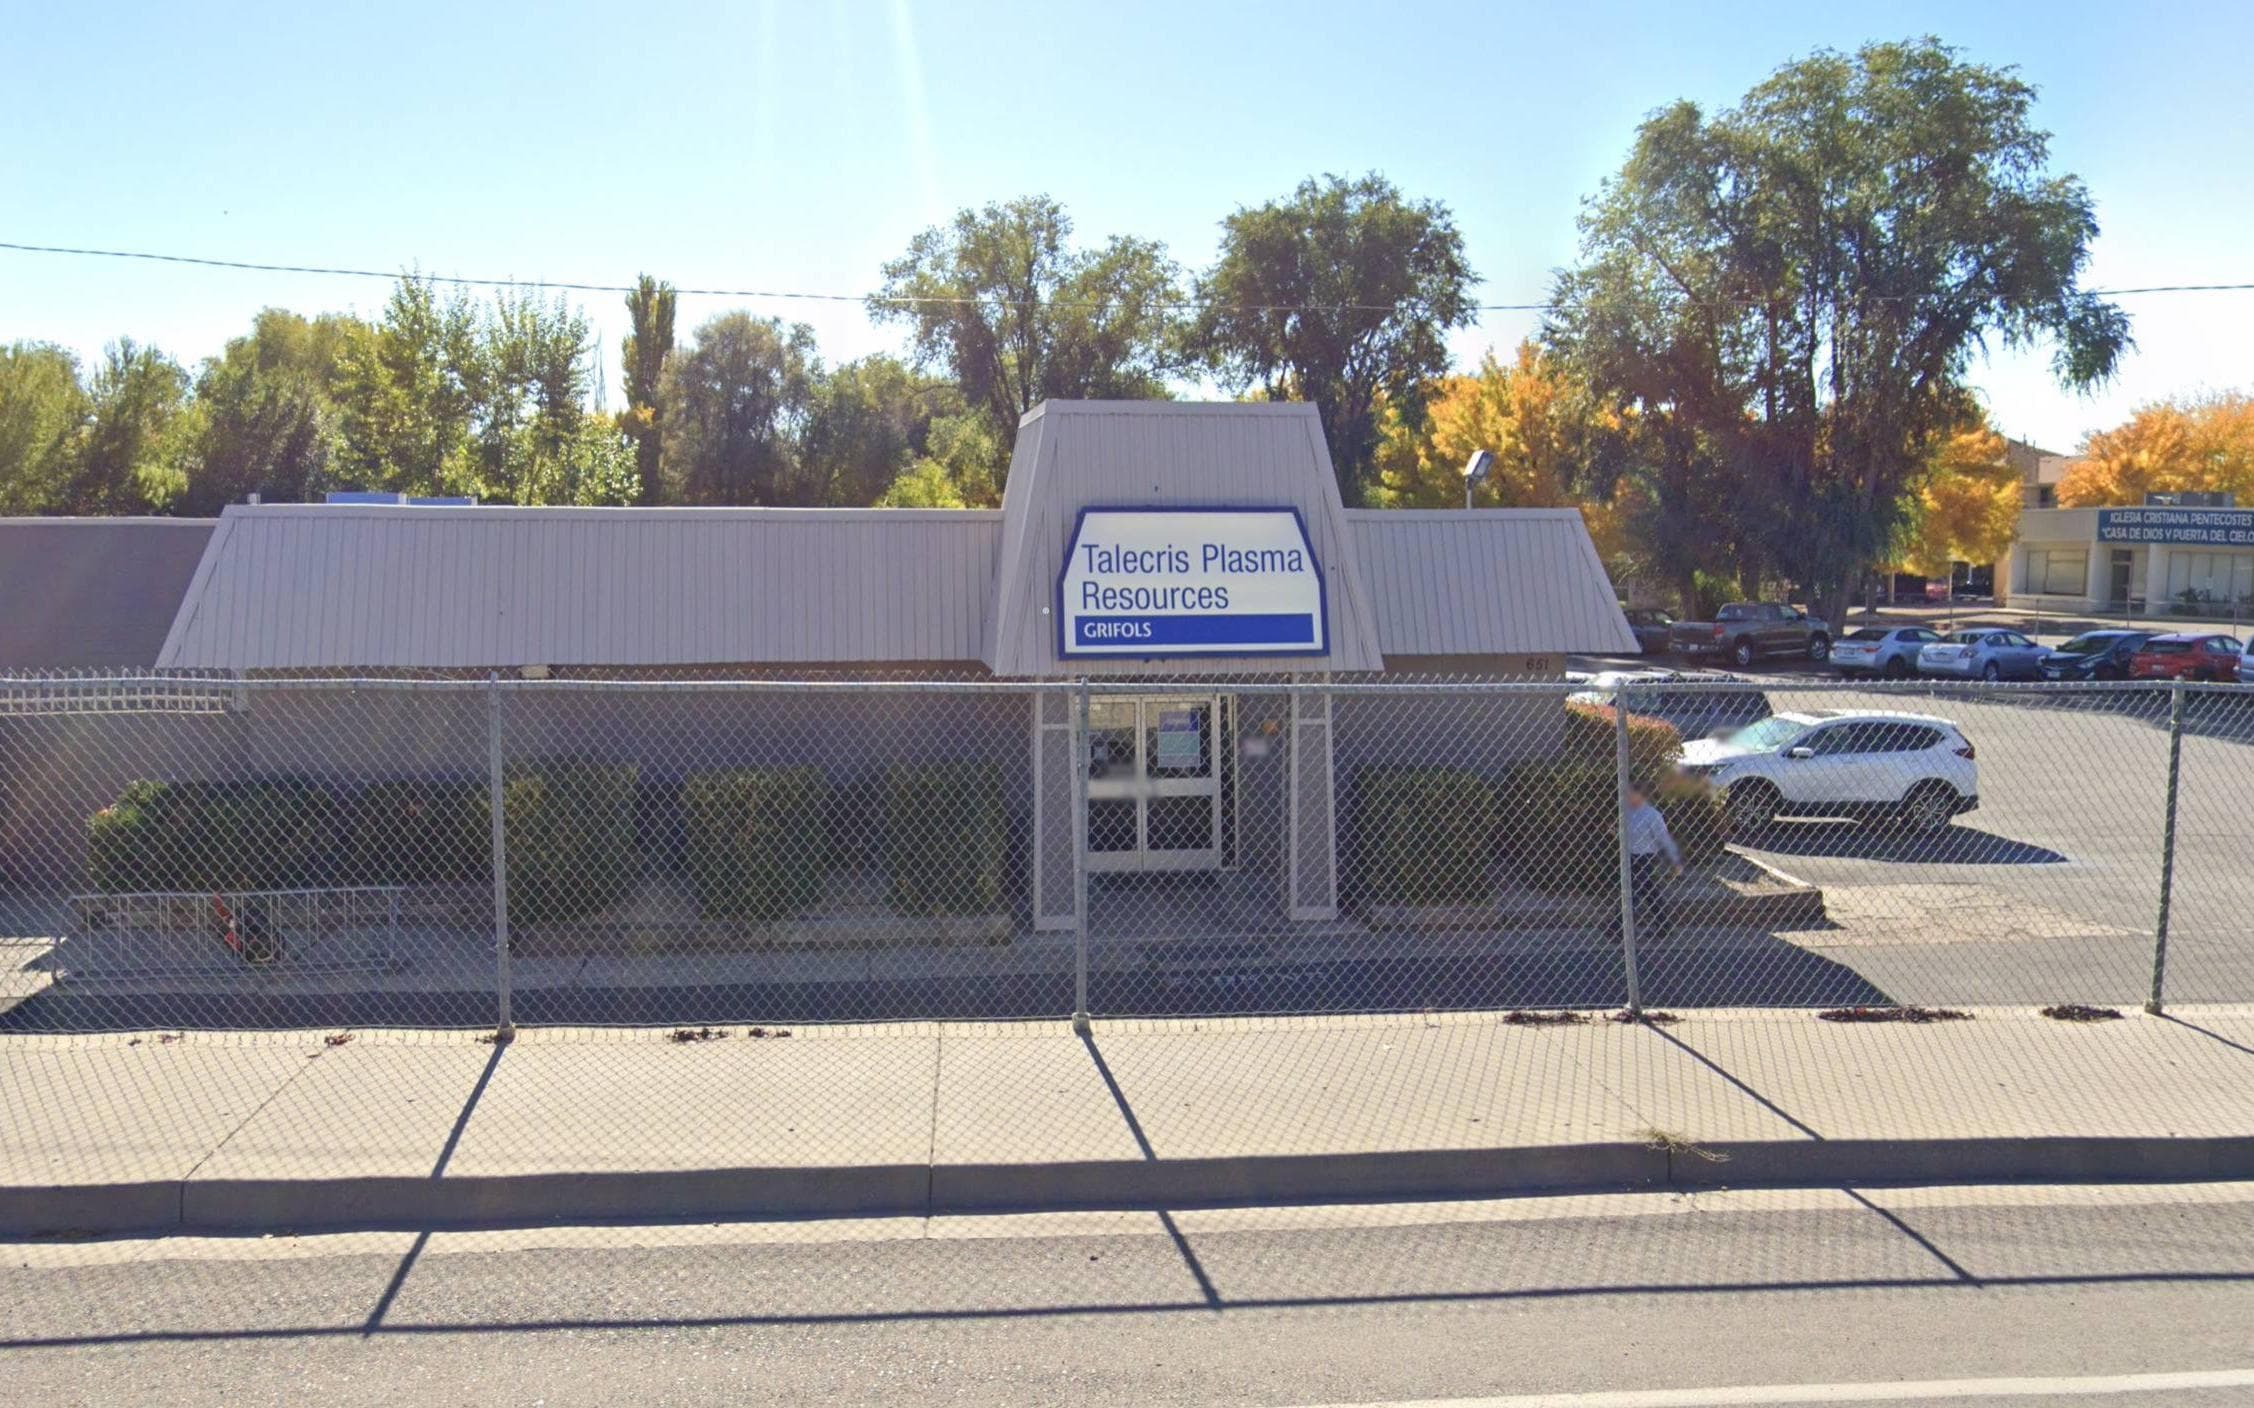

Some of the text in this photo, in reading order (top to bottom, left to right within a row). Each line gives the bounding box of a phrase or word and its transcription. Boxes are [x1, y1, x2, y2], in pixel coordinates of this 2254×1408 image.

[2110, 511, 2252, 526] IGLESIA CRISTIANA PENTECOSTES
[2128, 527, 2141, 540] DE
[2143, 527, 2163, 540] DIOS
[2165, 528, 2172, 540] Y
[2174, 528, 2208, 541] PUERTA
[2210, 528, 2227, 541] DEL
[1081, 544, 1304, 573] Talecris Plasma
[1082, 581, 1229, 610] Resources
[1084, 622, 1152, 638] GRIFOLS
[1526, 658, 1549, 670] 651
